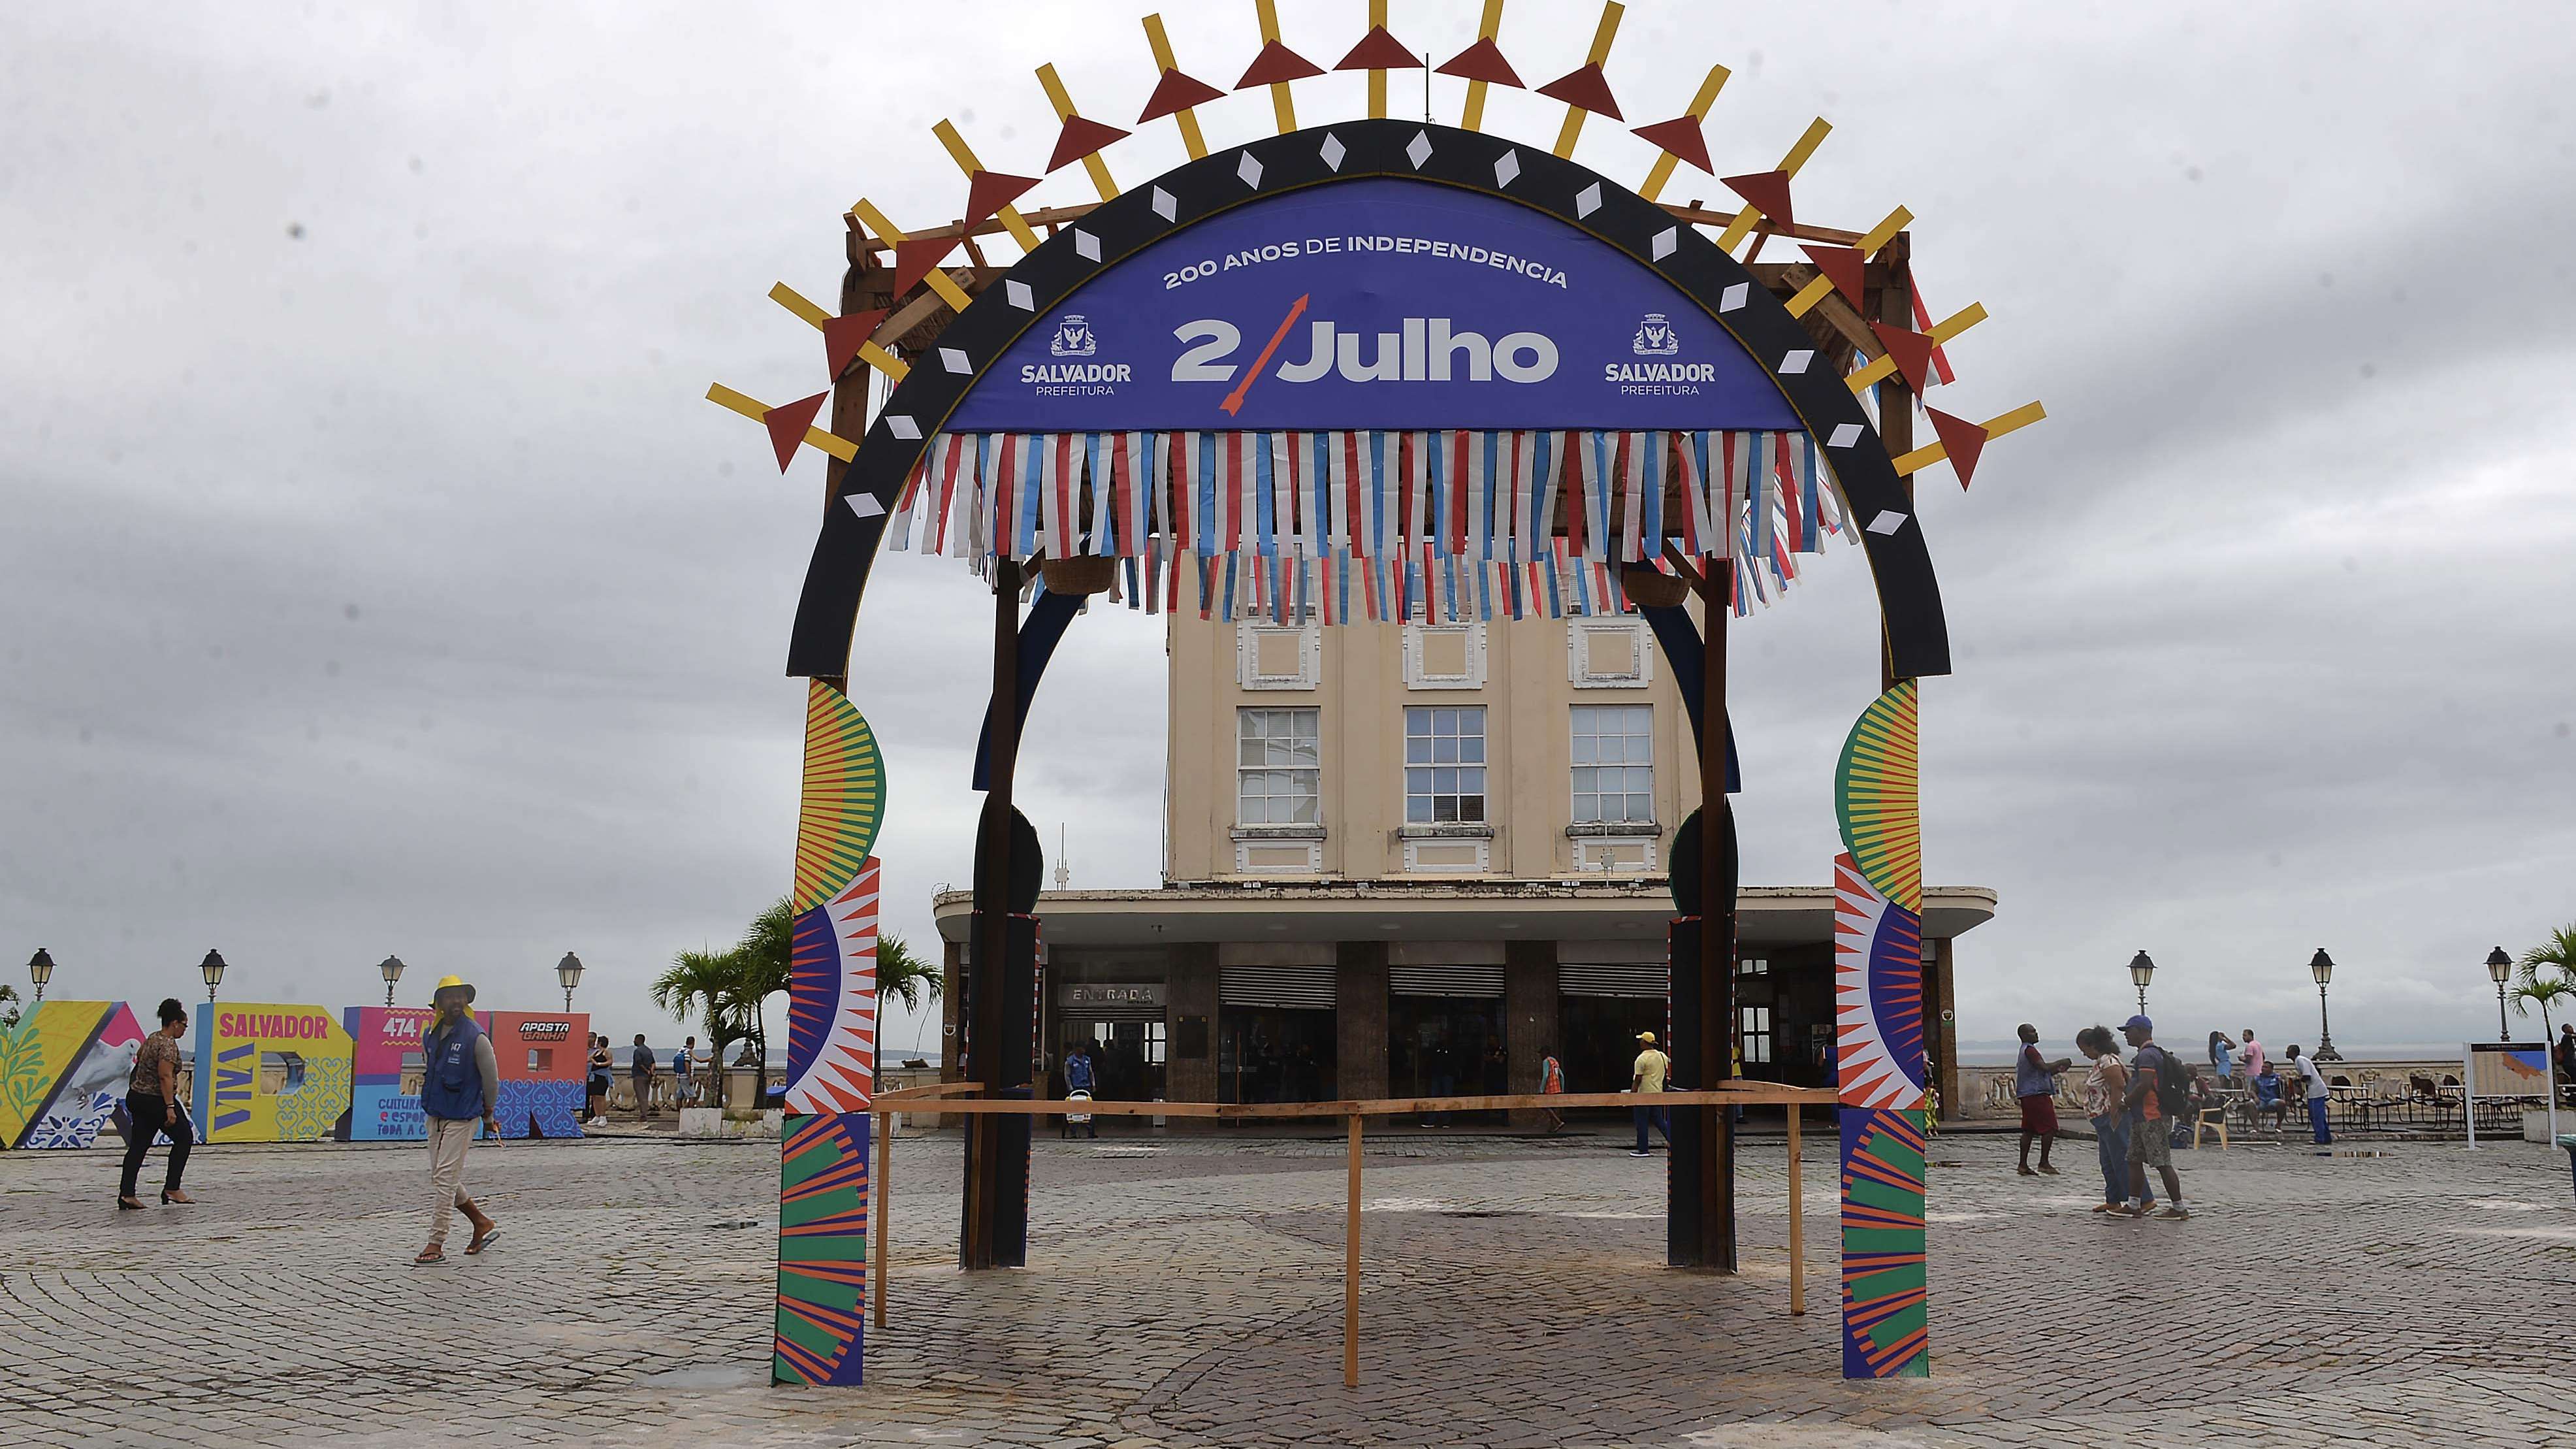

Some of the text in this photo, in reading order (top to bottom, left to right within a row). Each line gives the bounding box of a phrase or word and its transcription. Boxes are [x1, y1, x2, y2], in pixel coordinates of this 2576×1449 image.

[1163, 236, 1568, 290] 200 ANOS DE INDEPENDENCIA
[1171, 317, 1559, 383] 2 Julho
[1021, 364, 1131, 383] SALVADOR
[1605, 363, 1715, 382] SALVADOR
[1036, 385, 1114, 396] PREFEITURA
[1621, 385, 1699, 395] PREFEITURA
[1072, 988, 1153, 1000] ENTRADA
[219, 1013, 328, 1039] SALVADOR
[383, 1017, 417, 1037] 474
[520, 1022, 570, 1032] APOSTA
[214, 1041, 255, 1133] VIVA
[378, 1124, 402, 1135] TODA
[408, 1124, 414, 1135] A
